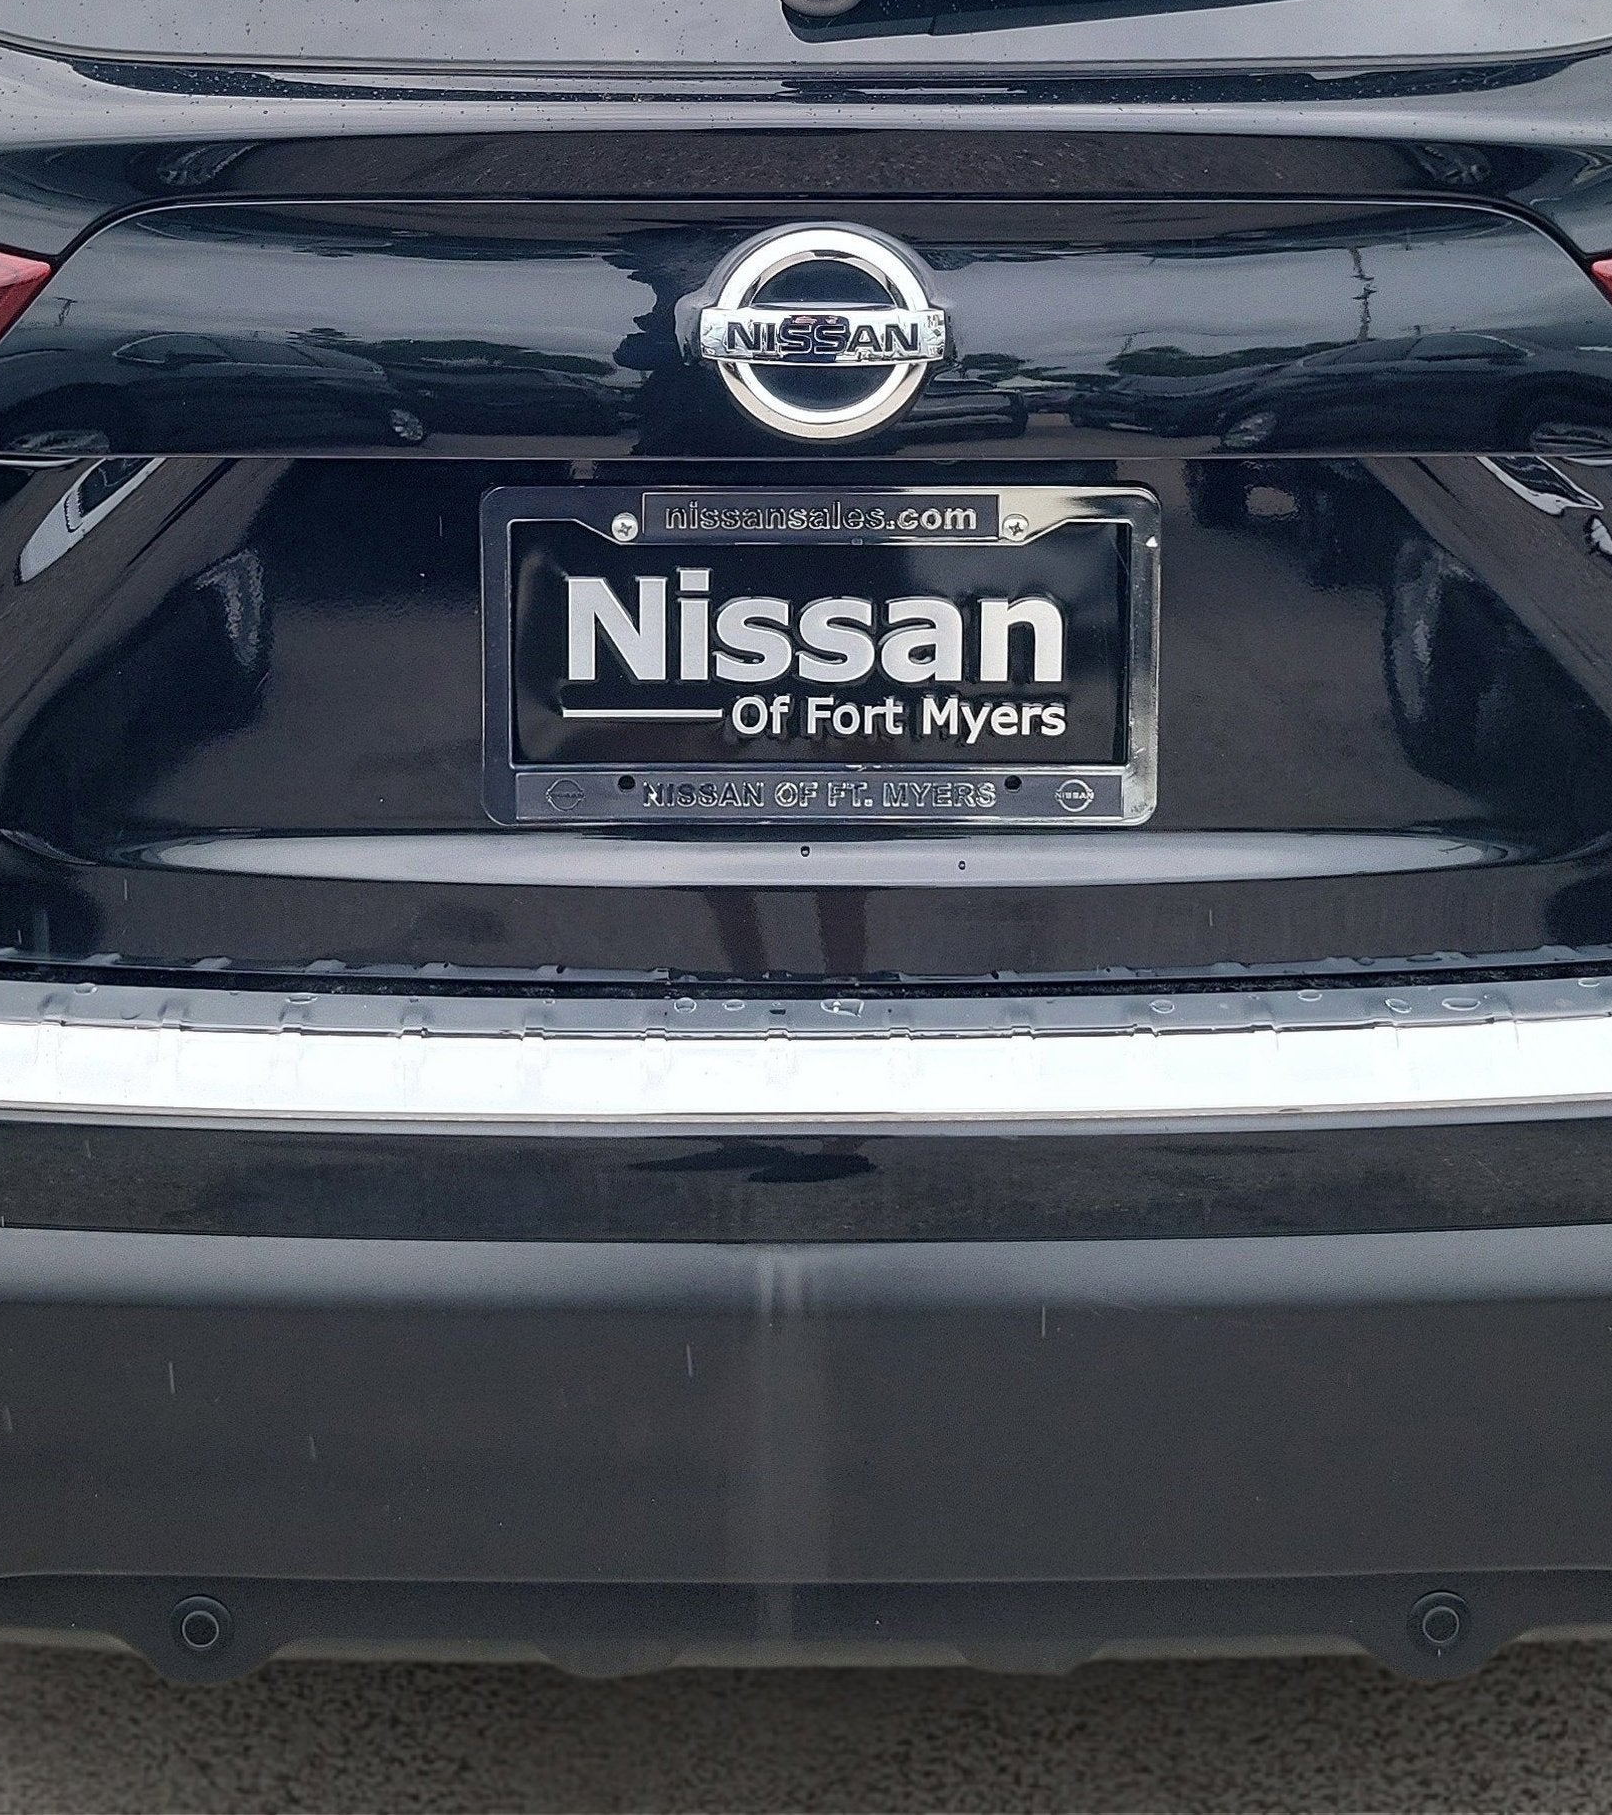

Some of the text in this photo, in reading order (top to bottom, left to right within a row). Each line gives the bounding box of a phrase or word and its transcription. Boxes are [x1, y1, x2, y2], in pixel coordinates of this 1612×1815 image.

[727, 322, 919, 353] NISSAN
[664, 501, 977, 532] nissansales.com
[565, 568, 1064, 683] Nissan
[732, 696, 1067, 744] Of Fort Myers
[643, 781, 997, 808] NISSAN OF FT. MYERS
